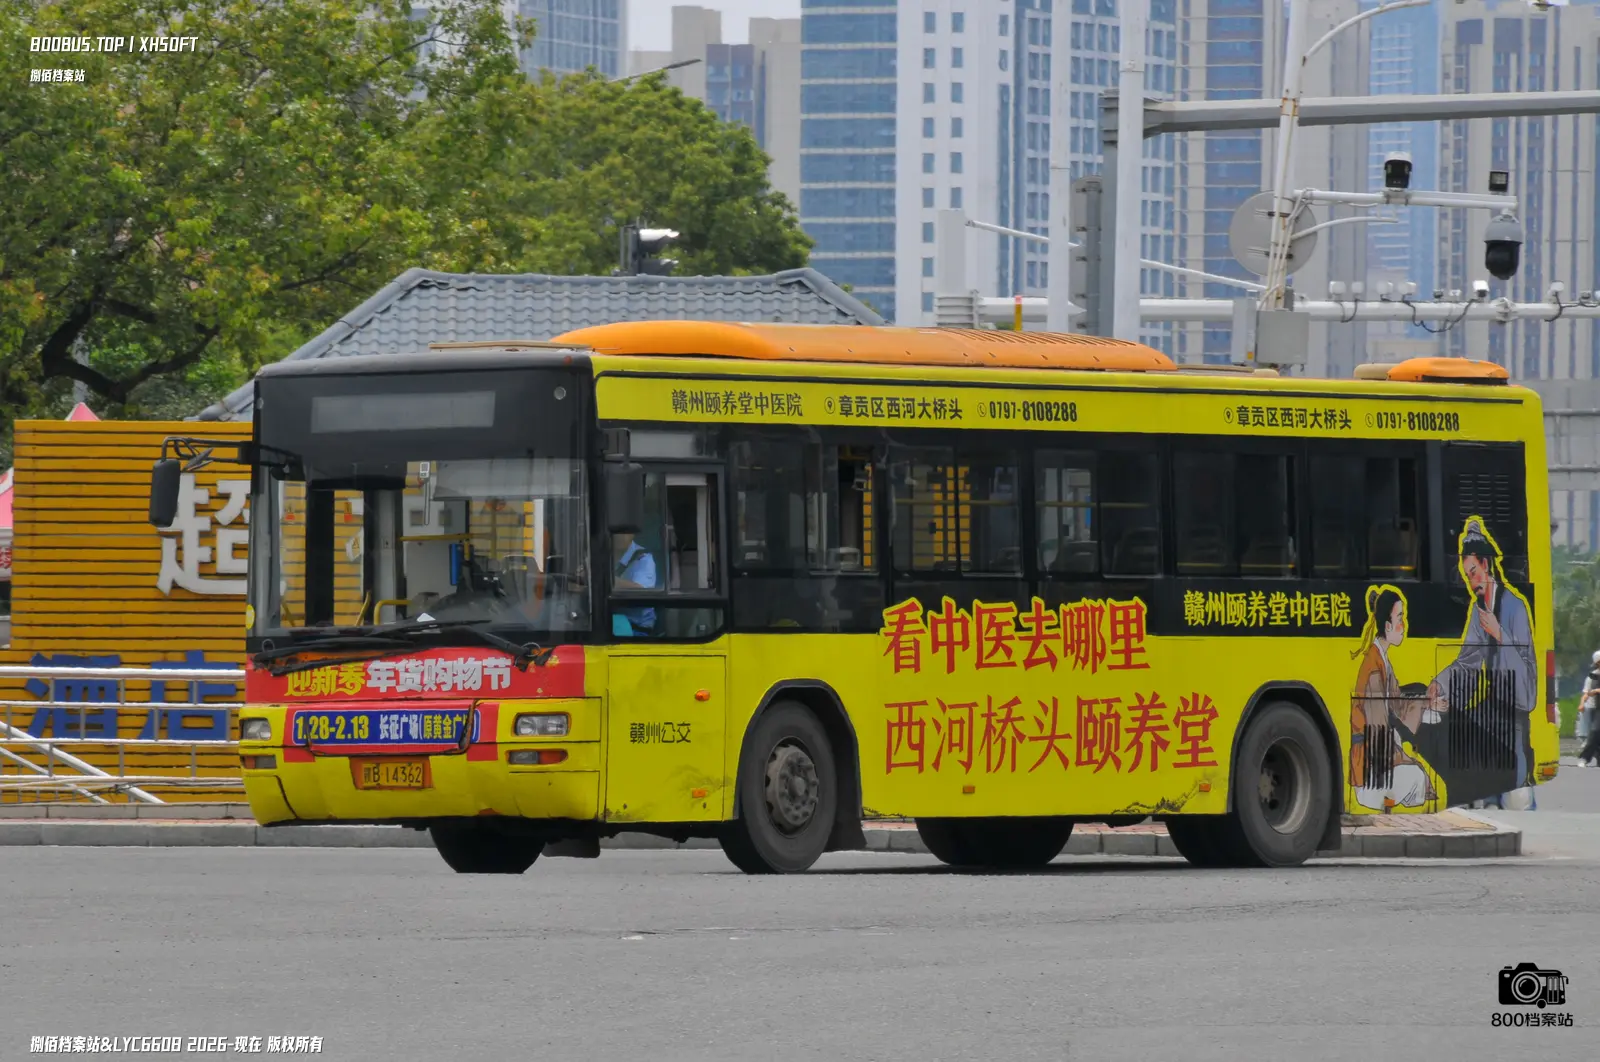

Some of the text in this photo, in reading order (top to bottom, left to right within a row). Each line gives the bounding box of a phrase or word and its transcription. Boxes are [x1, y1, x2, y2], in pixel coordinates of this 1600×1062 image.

[671, 389, 803, 417] 赣州颐养堂中医院
[838, 395, 1078, 423] 章贡区西河大桥头 0797-8108288
[1236, 405, 1460, 432] 章贡区西河大桥头 0797-8108288
[1184, 590, 1352, 627] 赣州颐养堂中医院
[882, 599, 1151, 674] 看中医去哪里
[25, 650, 237, 741] 酒店
[296, 713, 478, 741] 1.28-2.13 长征广场(原黄金广)
[629, 722, 692, 744] 赣州公交
[884, 690, 1219, 775] 西河桥头颐养堂
